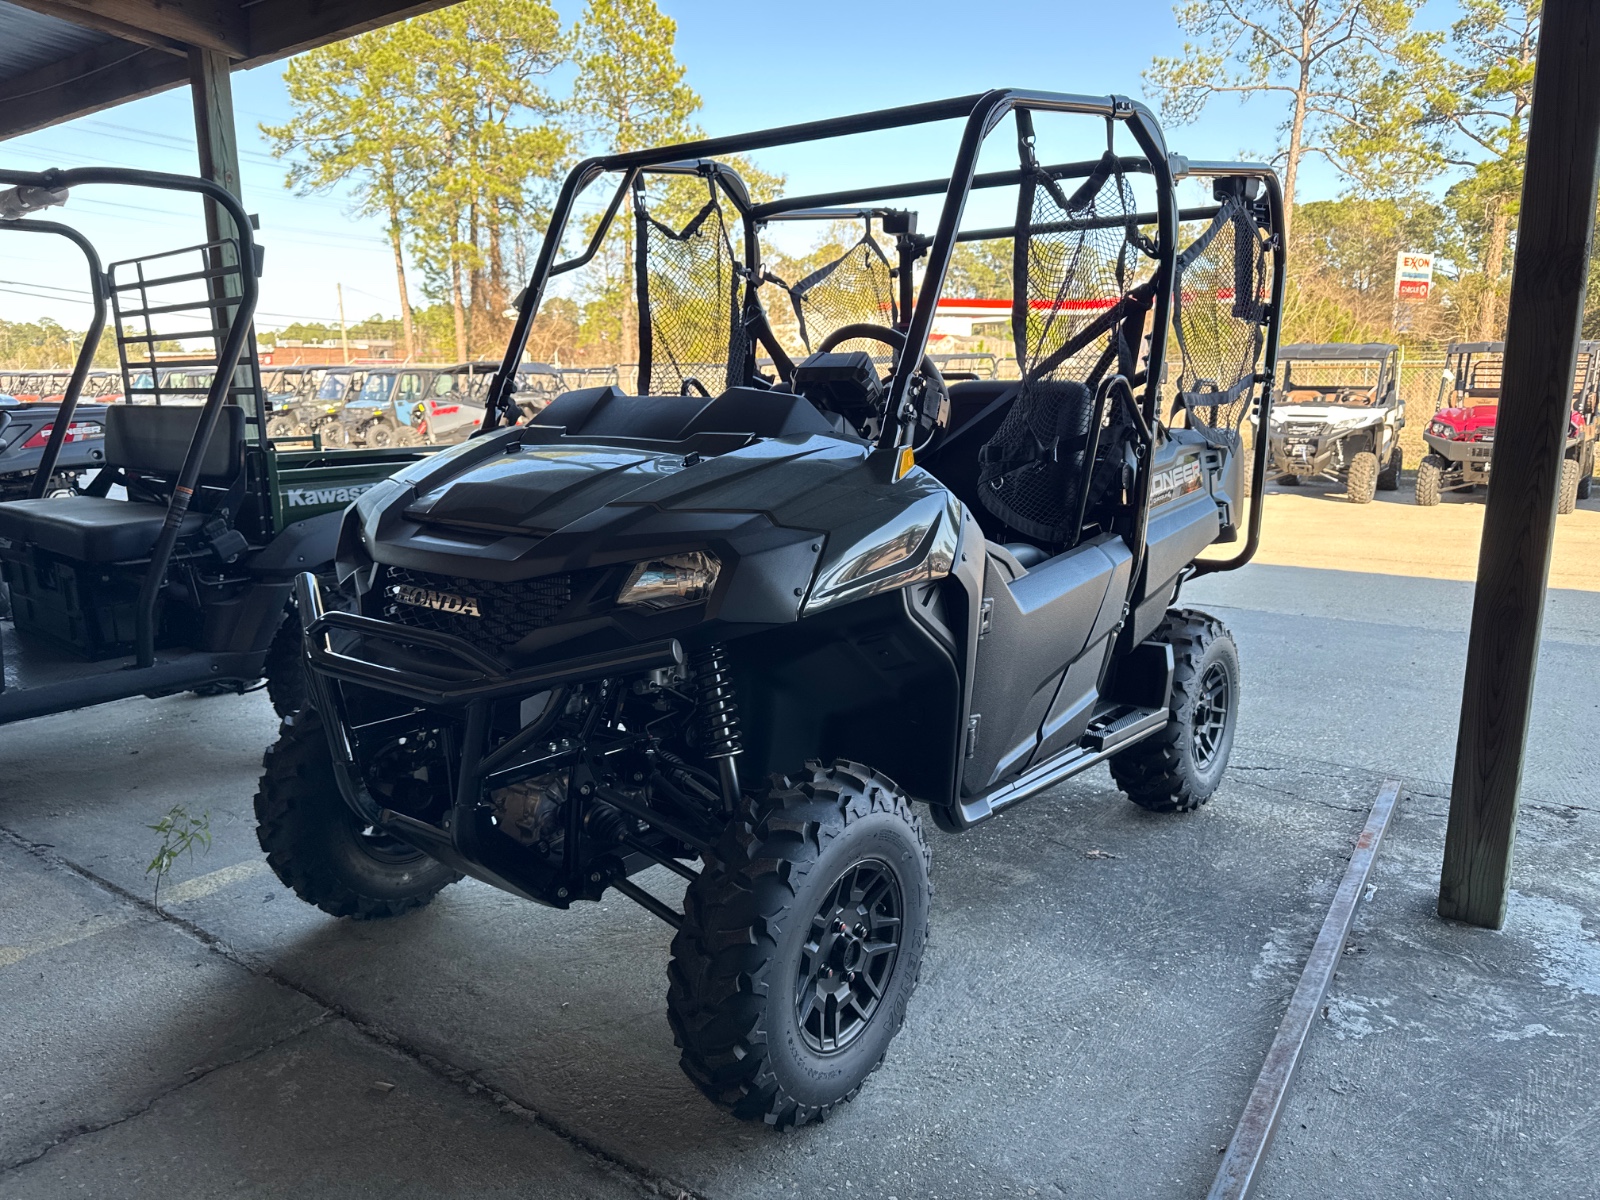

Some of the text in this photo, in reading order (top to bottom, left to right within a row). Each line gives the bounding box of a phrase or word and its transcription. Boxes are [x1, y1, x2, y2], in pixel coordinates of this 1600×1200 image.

[1403, 256, 1430, 271] EXXON
[41, 426, 101, 438] PNEER
[1152, 460, 1200, 494] ONEER
[287, 487, 370, 507] Kawas
[395, 584, 481, 617] HONDA
